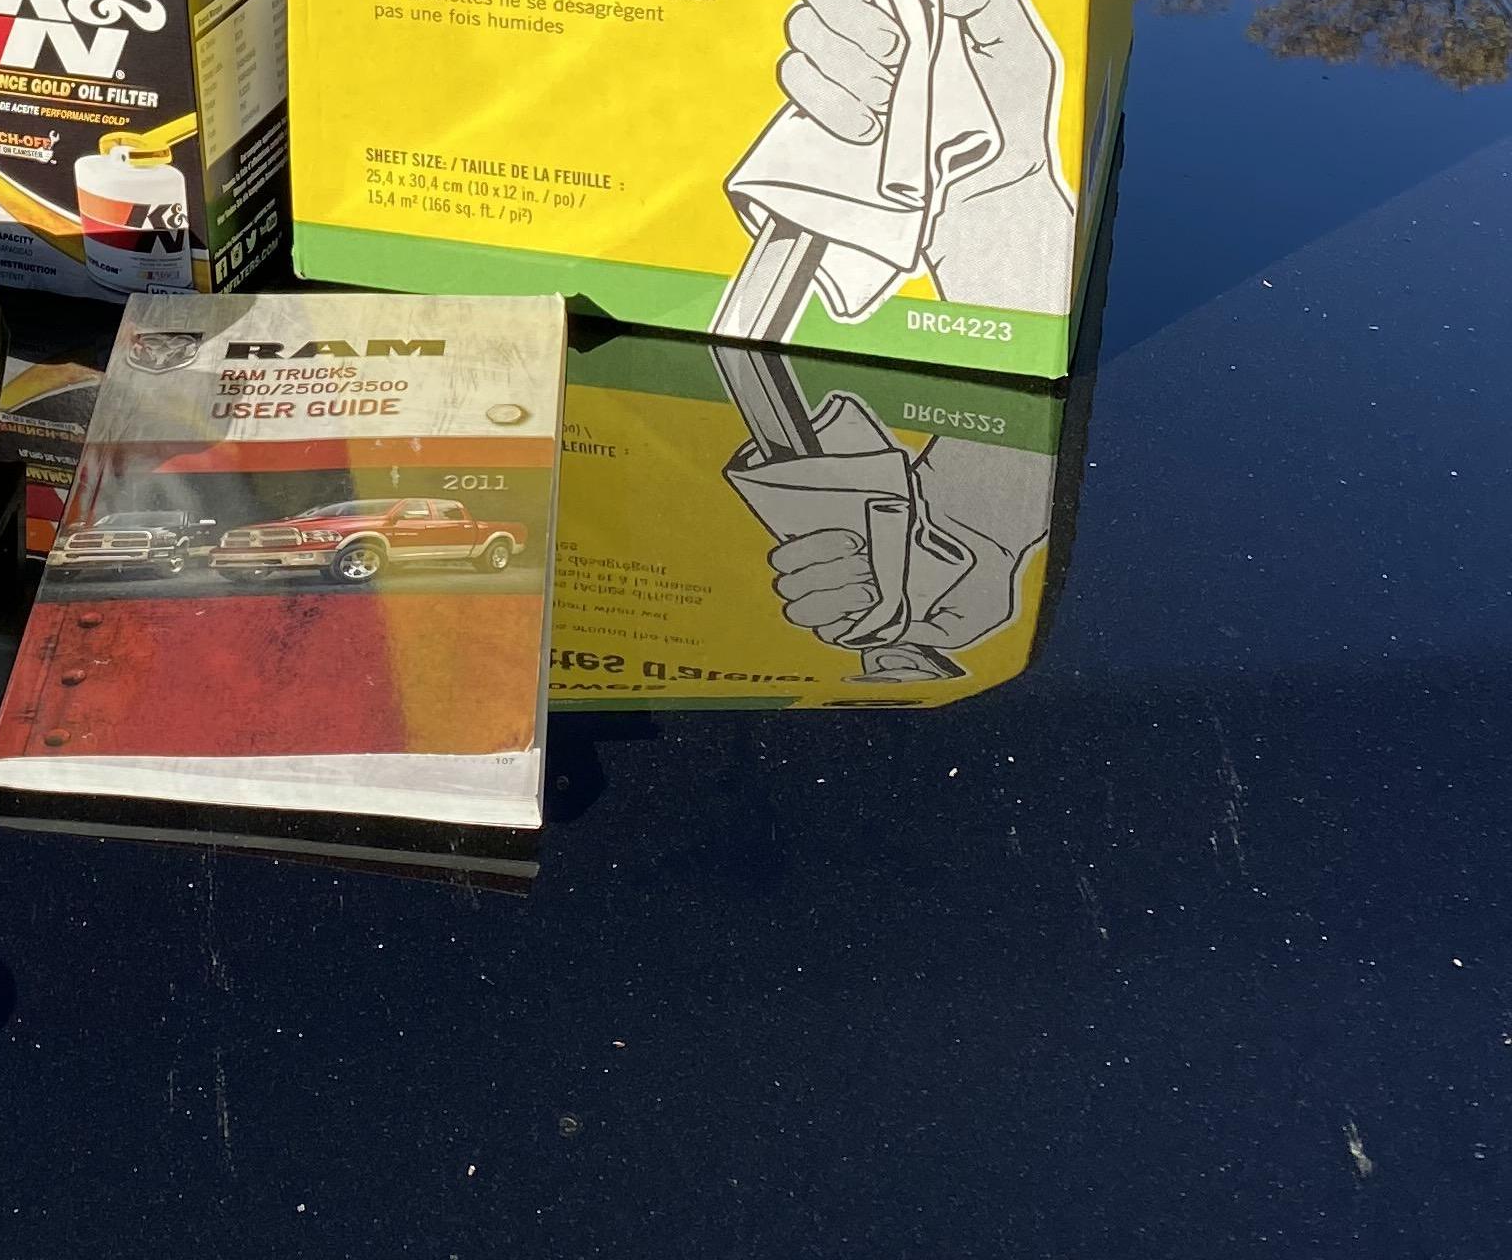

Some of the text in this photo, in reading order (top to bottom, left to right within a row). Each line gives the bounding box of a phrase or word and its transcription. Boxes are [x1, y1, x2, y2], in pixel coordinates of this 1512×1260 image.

[375, 5, 564, 34] pas une fois humides
[78, 84, 103, 101] OIL
[107, 87, 159, 107] FILTER
[0, 102, 10, 111] DE
[11, 104, 39, 115] ACEITE
[40, 107, 100, 124] PERFORMANCE
[366, 148, 408, 165] SHEET
[461, 158, 506, 177] TAILLE
[511, 164, 528, 179] DE
[534, 167, 550, 182] LA
[555, 170, 611, 189] FEUILLE
[366, 169, 393, 186] 25,4
[409, 174, 438, 190] 30,4
[443, 181, 463, 193] cm
[468, 182, 489, 197] (10
[503, 186, 517, 200] 12
[368, 189, 475, 217] 15,4 (166 sq.
[907, 311, 1012, 341] DRC4223
[224, 340, 446, 359] RAM
[220, 366, 358, 381] RAM TRUCKS
[216, 381, 409, 396] 1500/2500/3500
[212, 398, 401, 419] USER GUIDE
[443, 475, 509, 490] 2011
